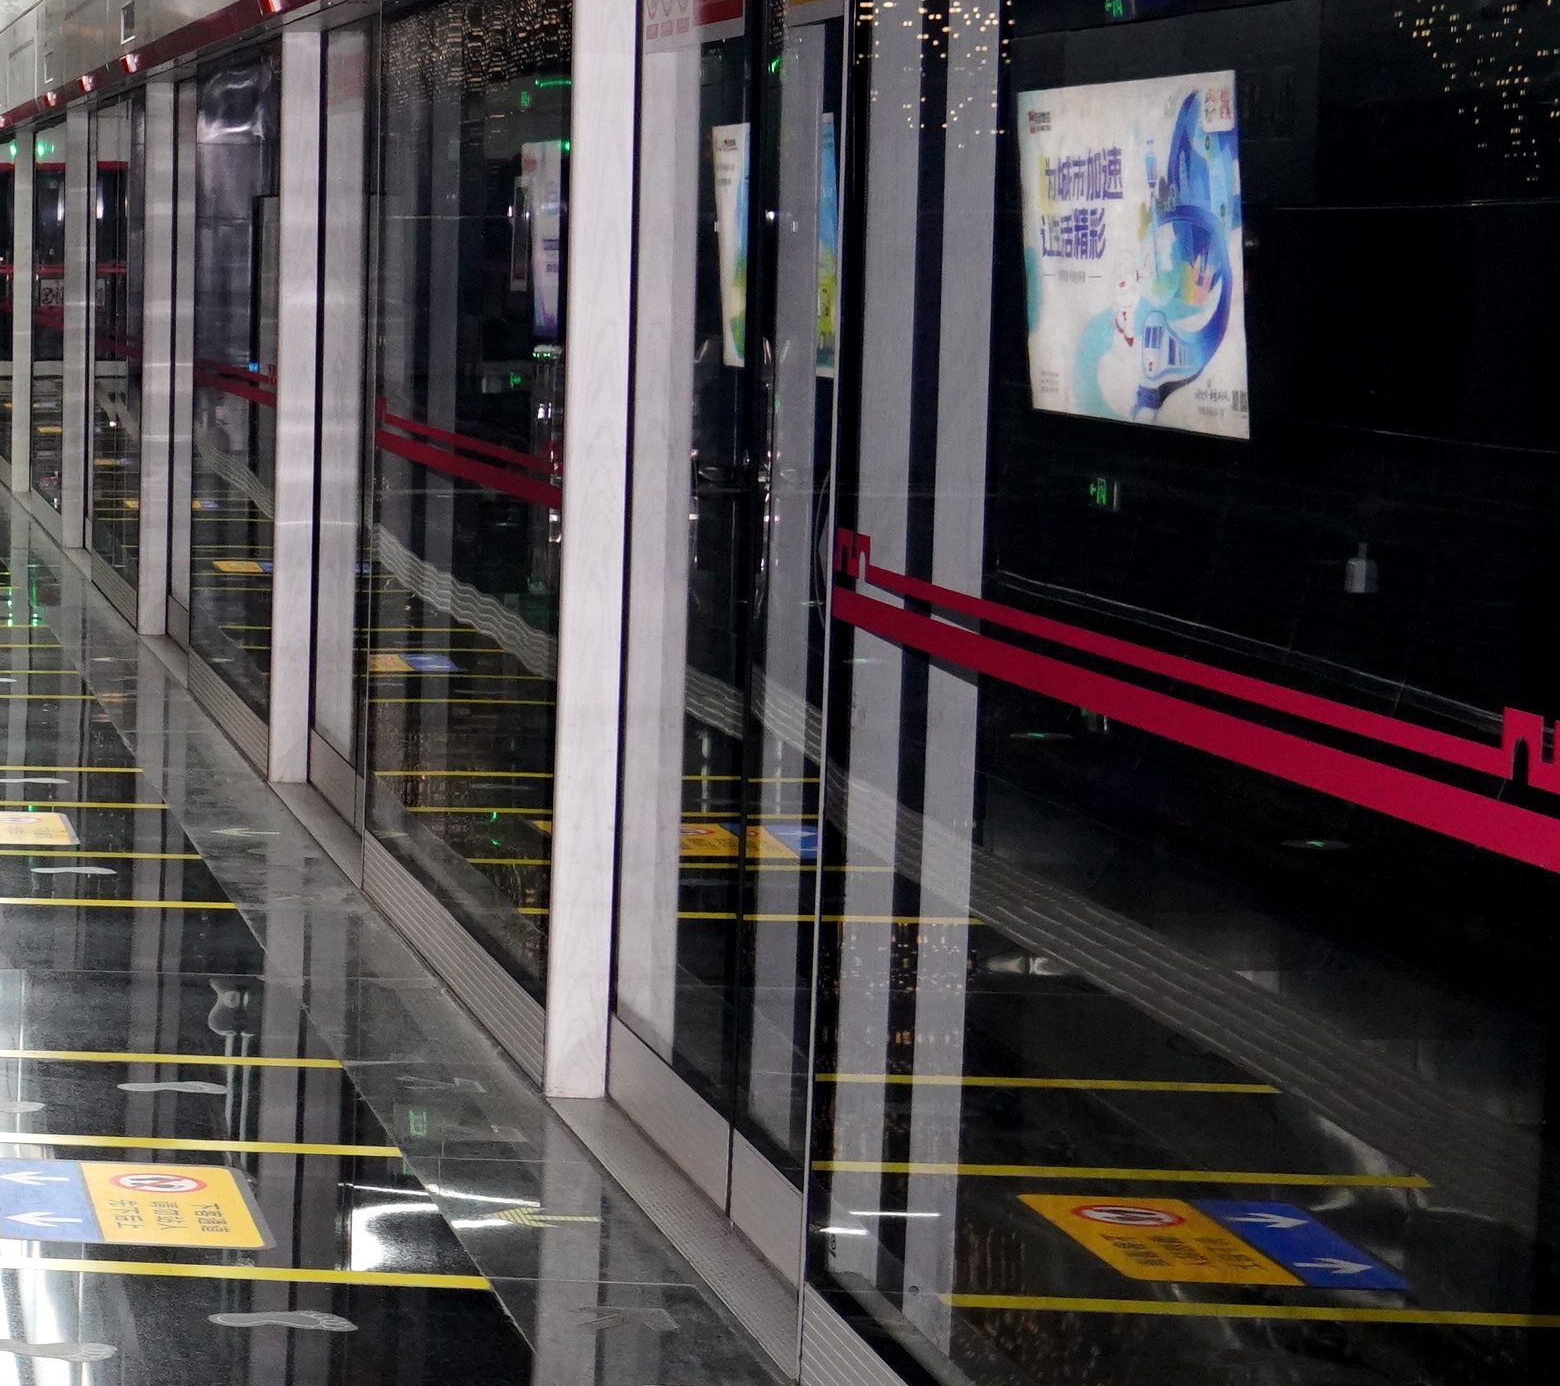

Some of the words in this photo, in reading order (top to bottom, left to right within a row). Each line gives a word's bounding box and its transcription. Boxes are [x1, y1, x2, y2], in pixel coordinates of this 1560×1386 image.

[1045, 146, 1124, 202] 为城市加速
[1042, 207, 1107, 260] 让生活精彩
